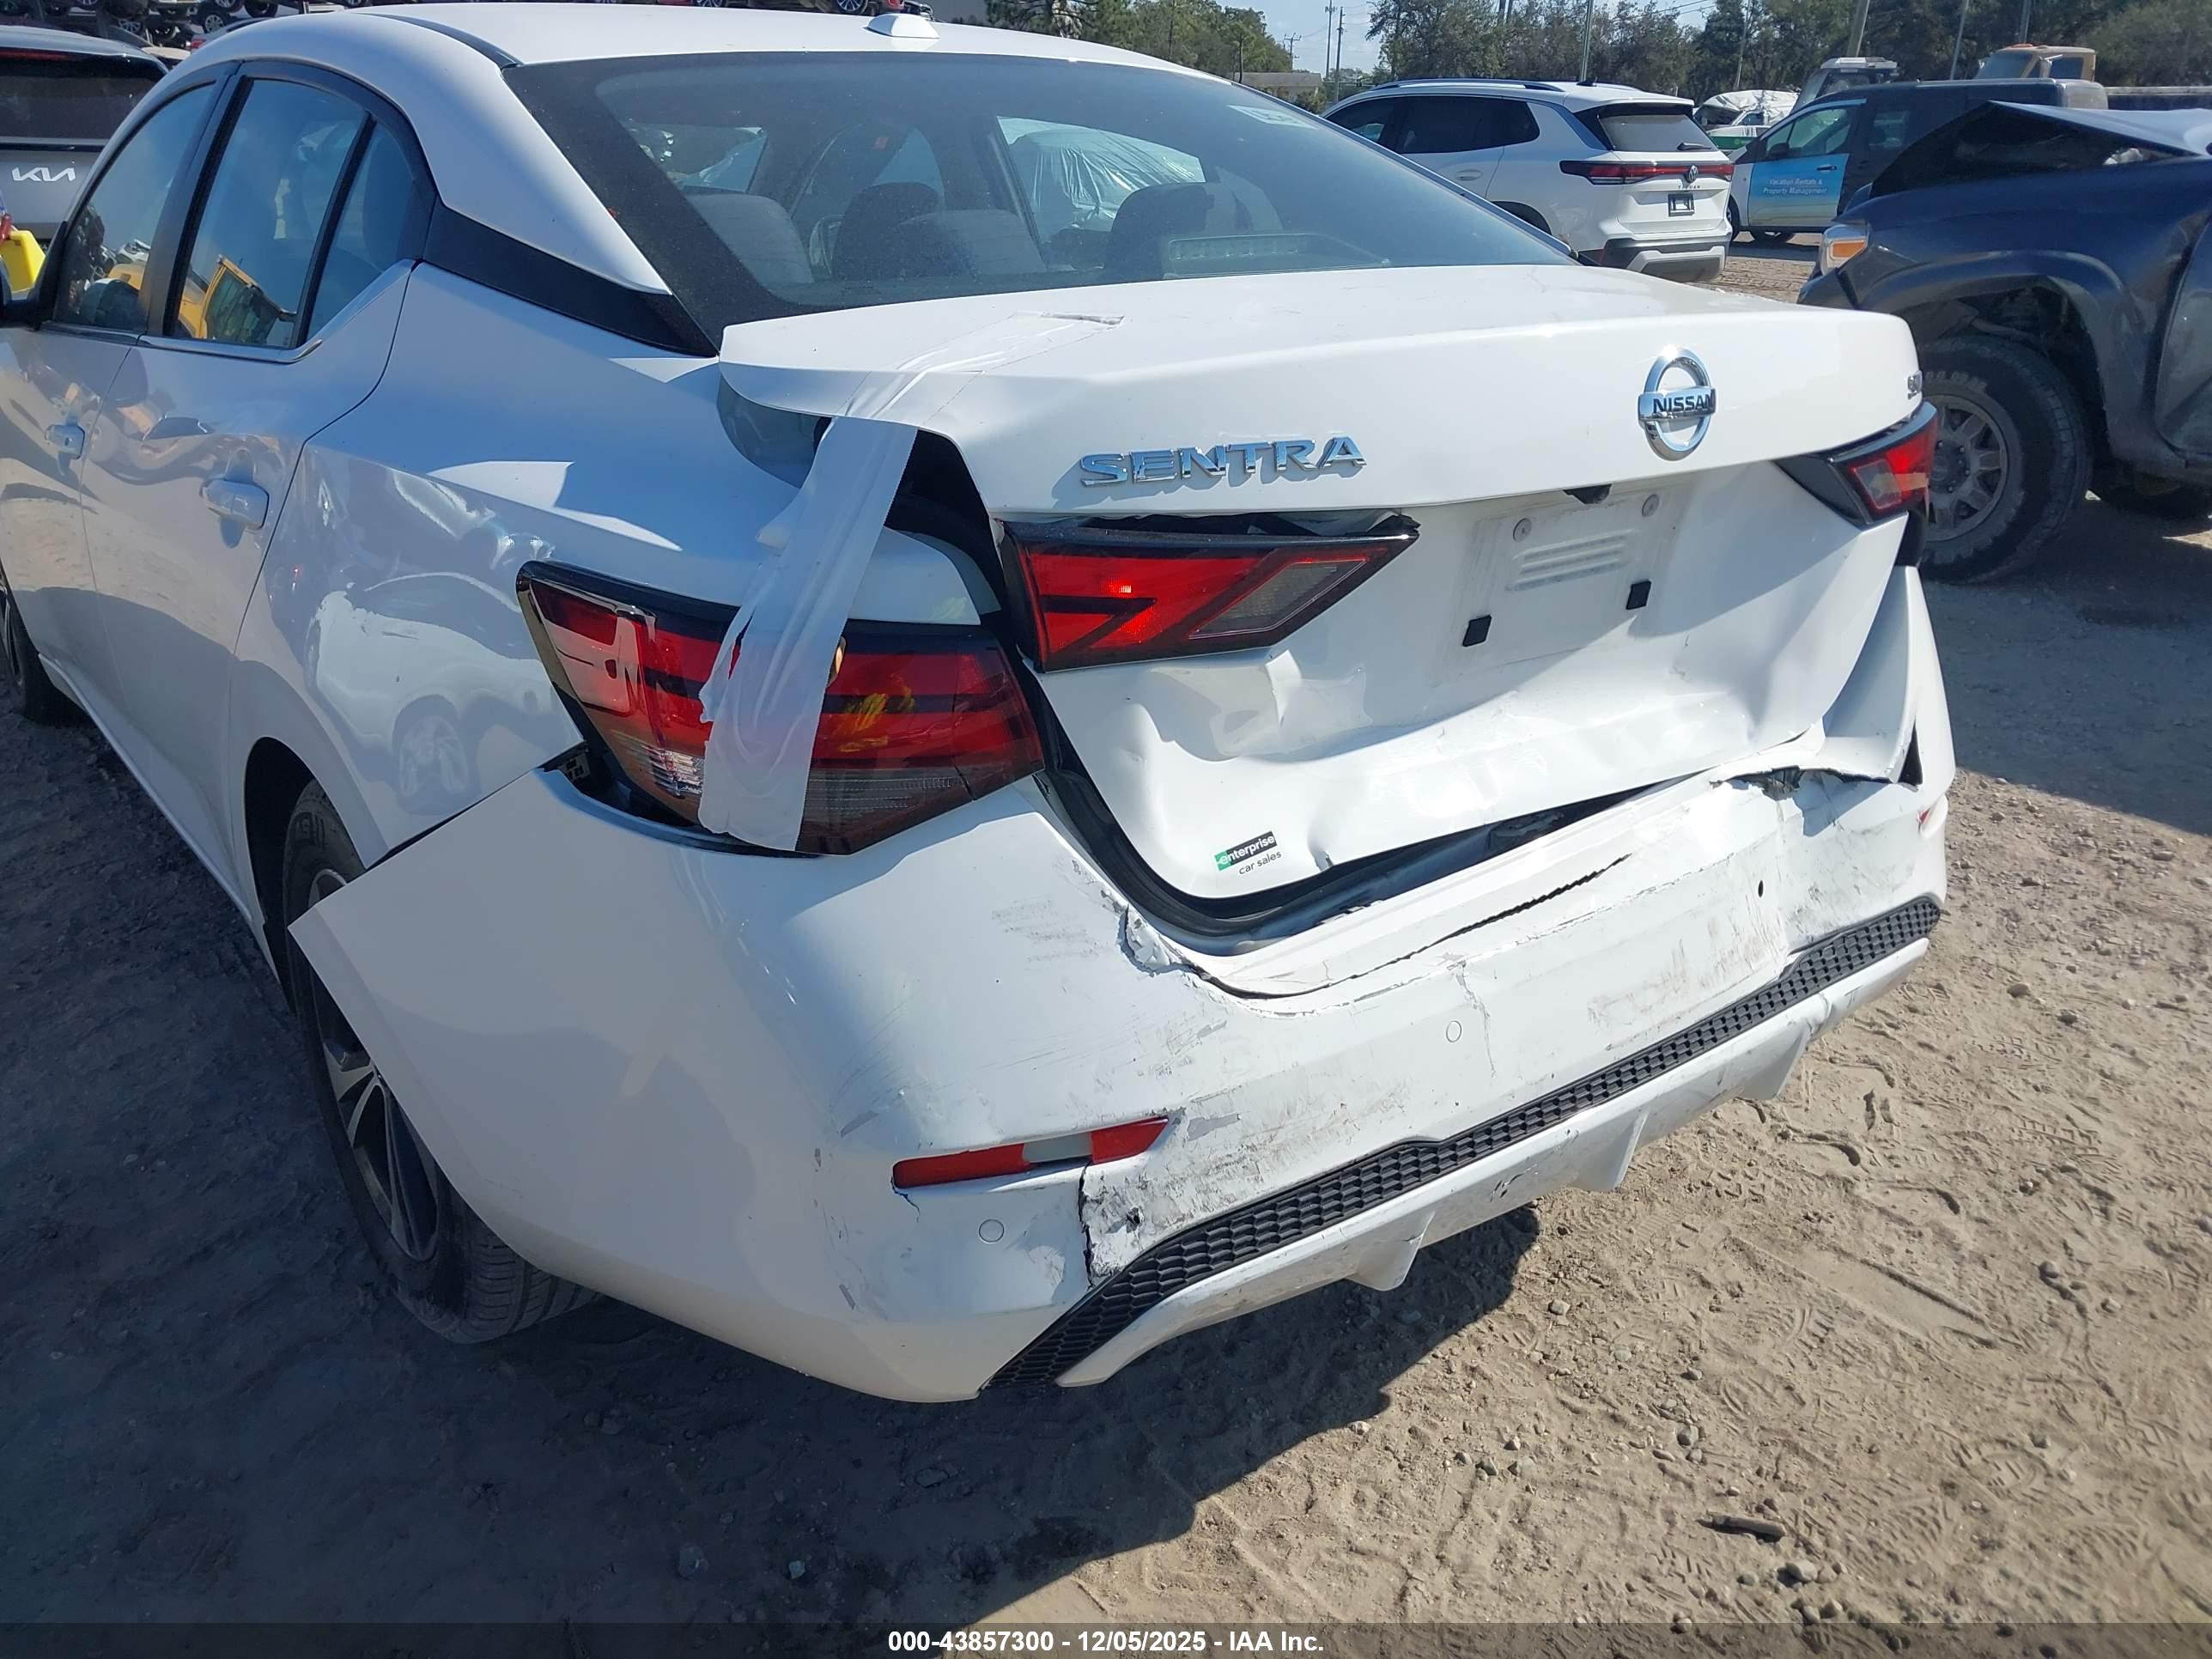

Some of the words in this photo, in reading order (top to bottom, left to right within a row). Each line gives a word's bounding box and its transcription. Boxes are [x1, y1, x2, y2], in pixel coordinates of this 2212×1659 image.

[11, 167, 76, 181] KIA
[1763, 186, 1788, 195] Property
[1789, 186, 1827, 195] Management
[1652, 394, 1713, 414] NISSAN
[1079, 435, 1368, 488] SENTRA
[1218, 836, 1275, 865] enterprise
[1239, 861, 1255, 874] car
[1256, 851, 1282, 867] sales
